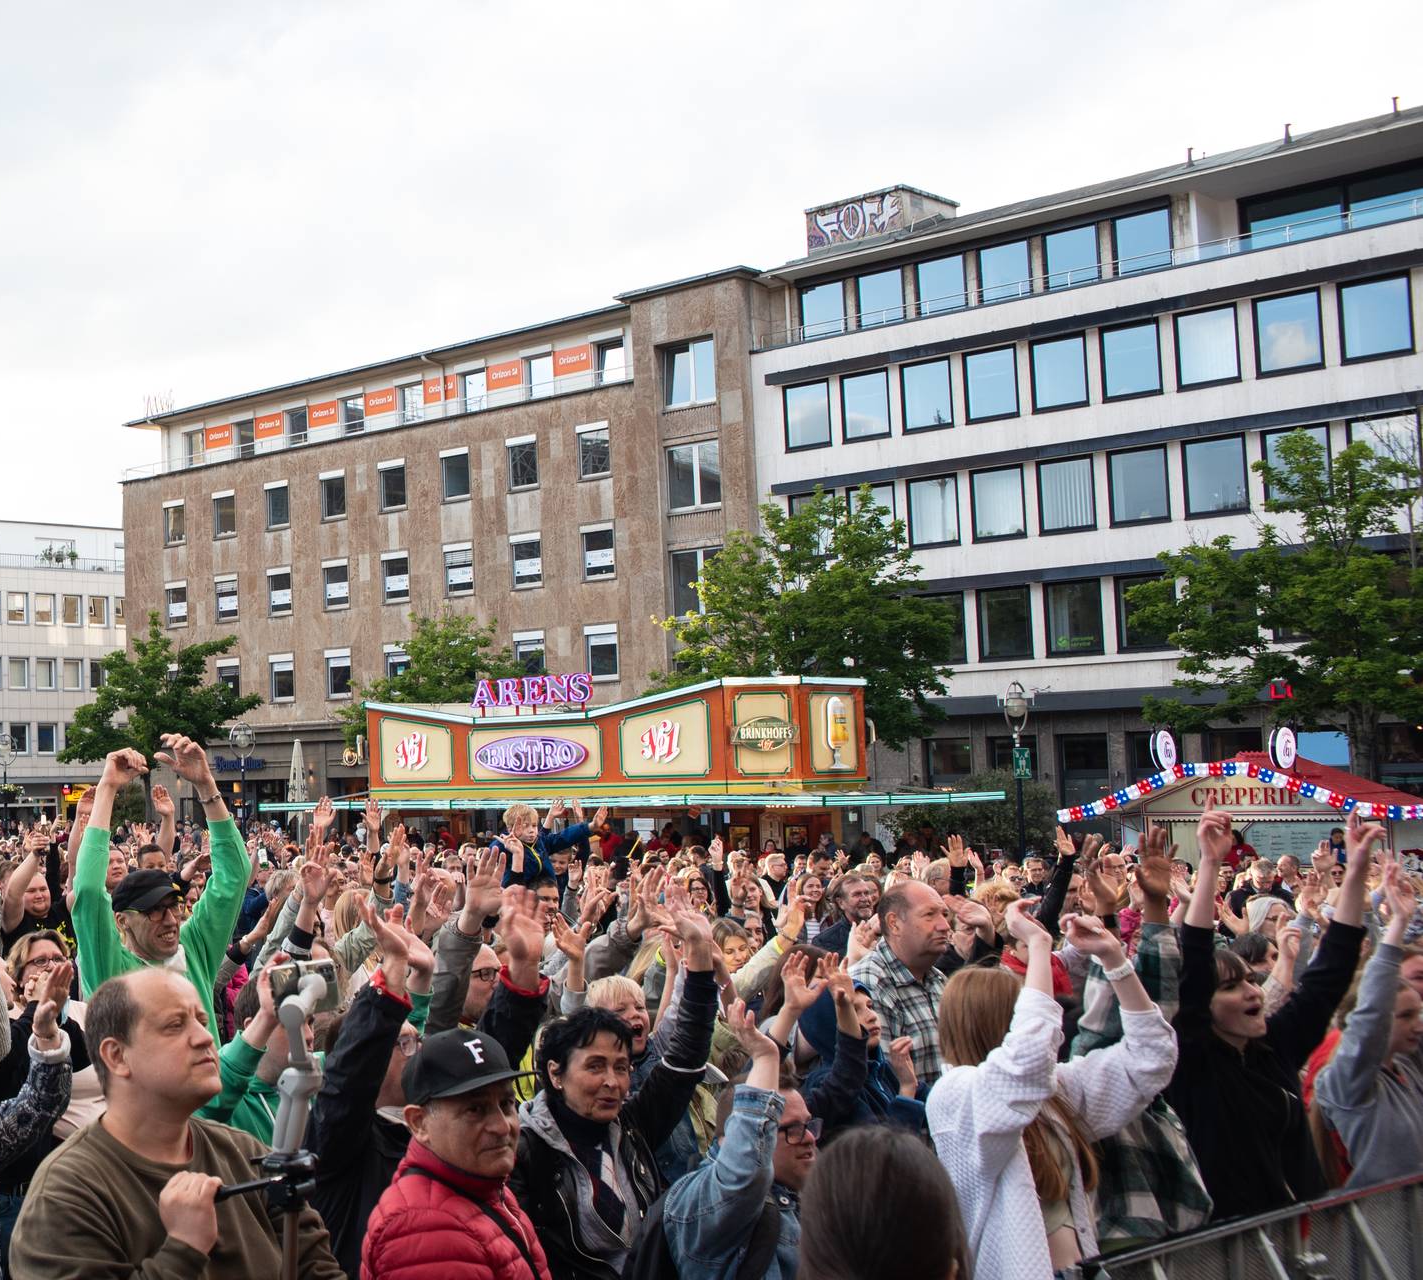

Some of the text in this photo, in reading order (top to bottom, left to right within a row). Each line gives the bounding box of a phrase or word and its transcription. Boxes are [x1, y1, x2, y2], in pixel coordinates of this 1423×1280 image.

[559, 354, 580, 365] Orizon
[492, 368, 511, 380] Orizon
[369, 396, 387, 406] Orizon
[312, 409, 329, 418] Orizon
[258, 421, 275, 430] Orizon
[209, 431, 224, 440] Orizon
[471, 673, 592, 708] ARENS
[486, 739, 576, 771] BISTRO
[1191, 783, 1302, 806] CRÊPERIE
[463, 1038, 484, 1064] F
